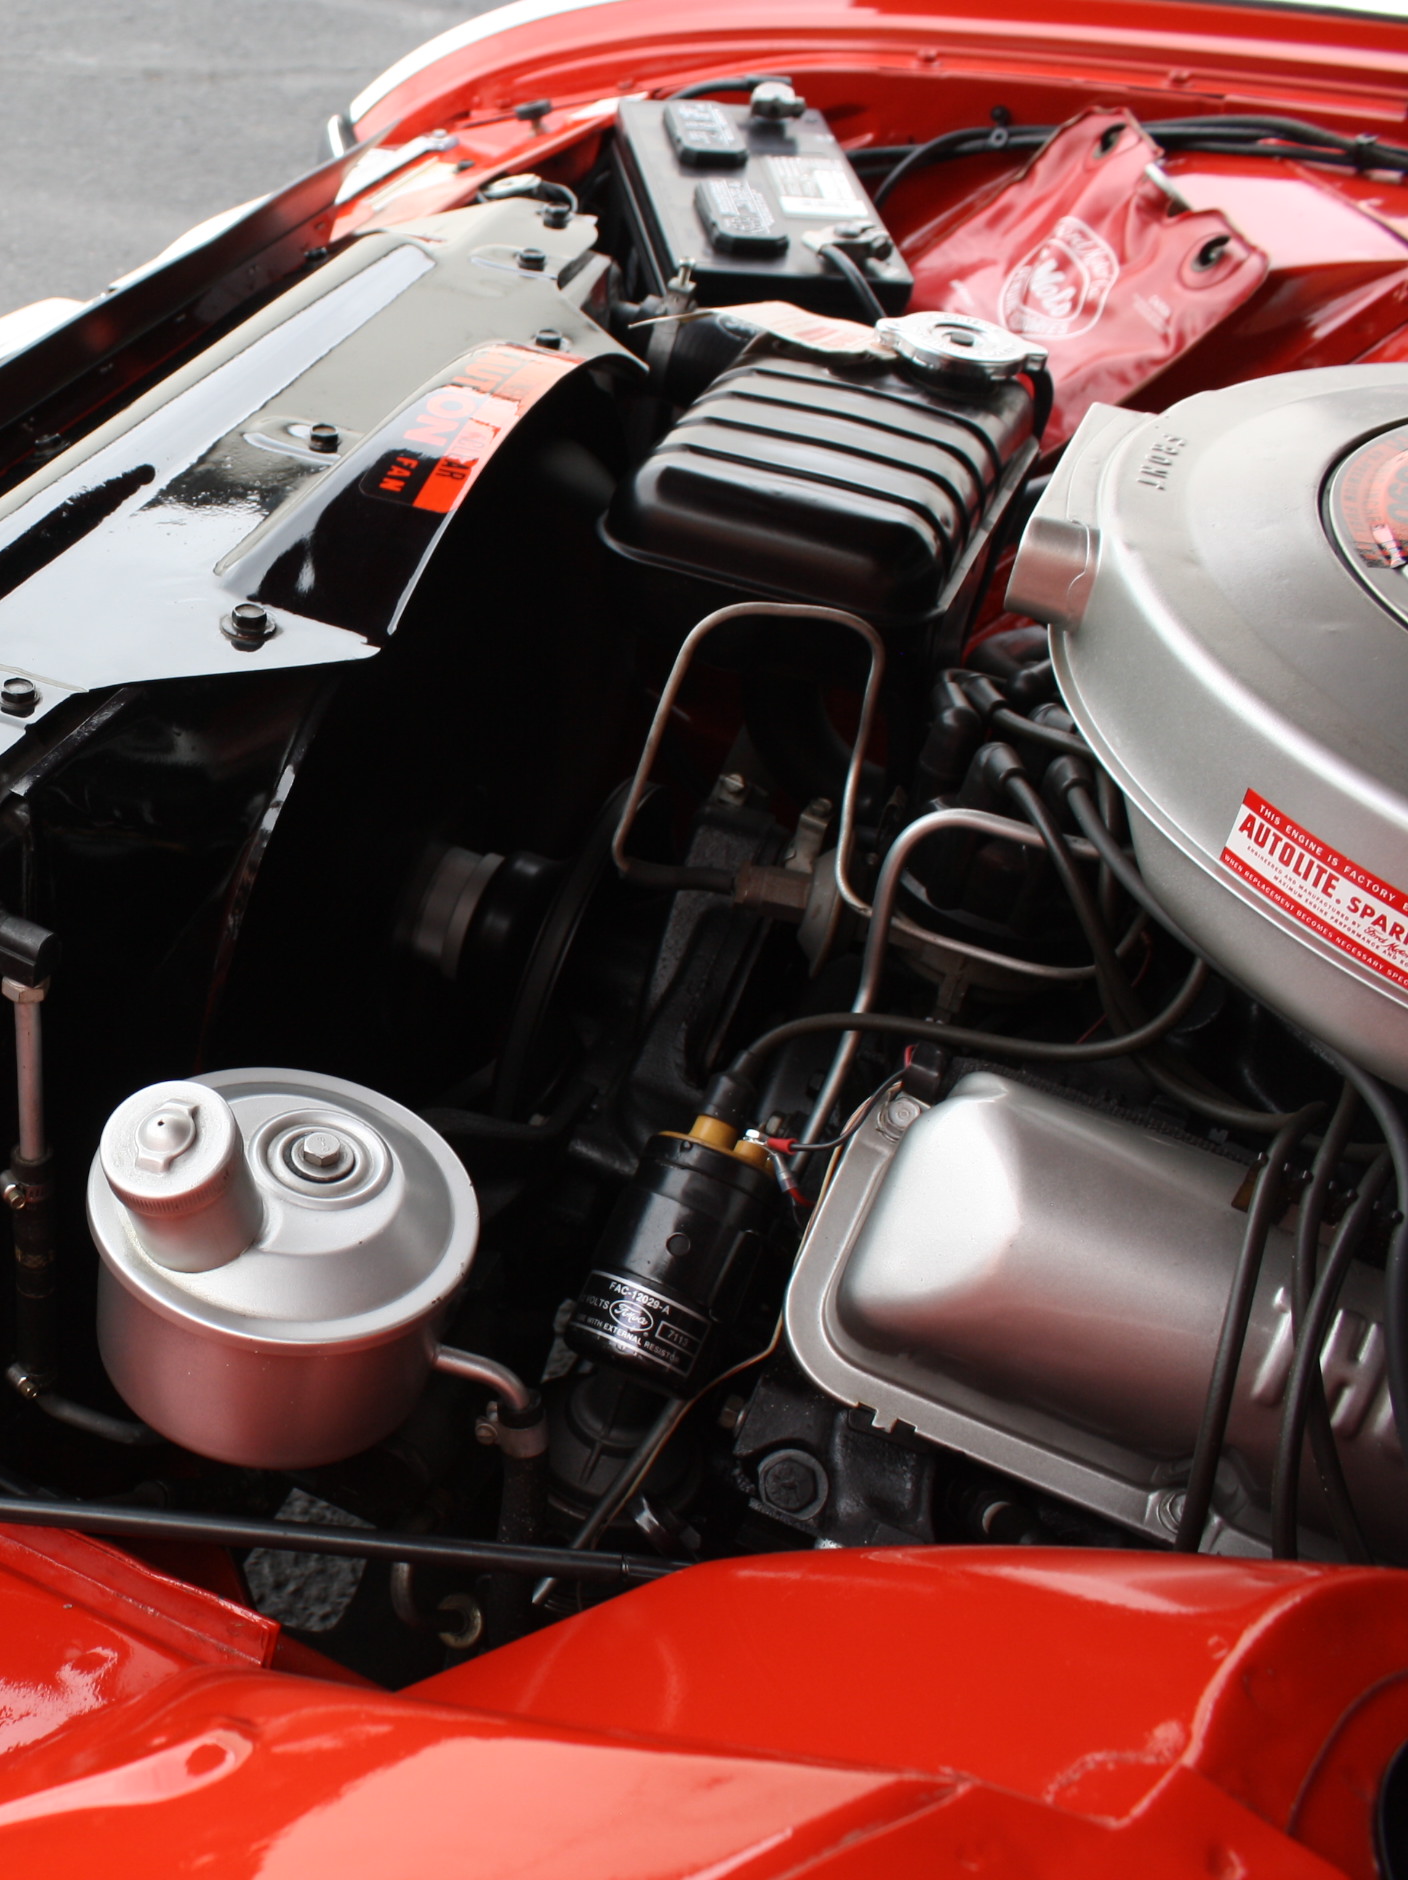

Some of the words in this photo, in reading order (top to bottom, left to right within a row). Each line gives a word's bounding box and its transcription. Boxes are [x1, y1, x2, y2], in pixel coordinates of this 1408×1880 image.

[379, 456, 419, 492] FAN
[1259, 804, 1281, 826] THIS
[1285, 825, 1323, 856] ENGINE
[1327, 854, 1339, 866] IS
[1344, 865, 1396, 902] FACTORY
[1224, 853, 1243, 873] WHEN
[1244, 870, 1295, 911] REPLACEMENT
[1296, 909, 1333, 938] BECOMES
[1335, 936, 1384, 971] NECESSARY
[1273, 875, 1303, 899] MAXIMUM
[1305, 898, 1328, 917] ENGINE
[1330, 915, 1380, 950] PERFORMANCE
[1284, 874, 1298, 886] AND
[1298, 884, 1349, 921] MANUFACTURED
[1346, 896, 1408, 946] SPAR
[608, 1281, 671, 1316] FAC-12029-A
[602, 1322, 643, 1347] EXTERNAL
